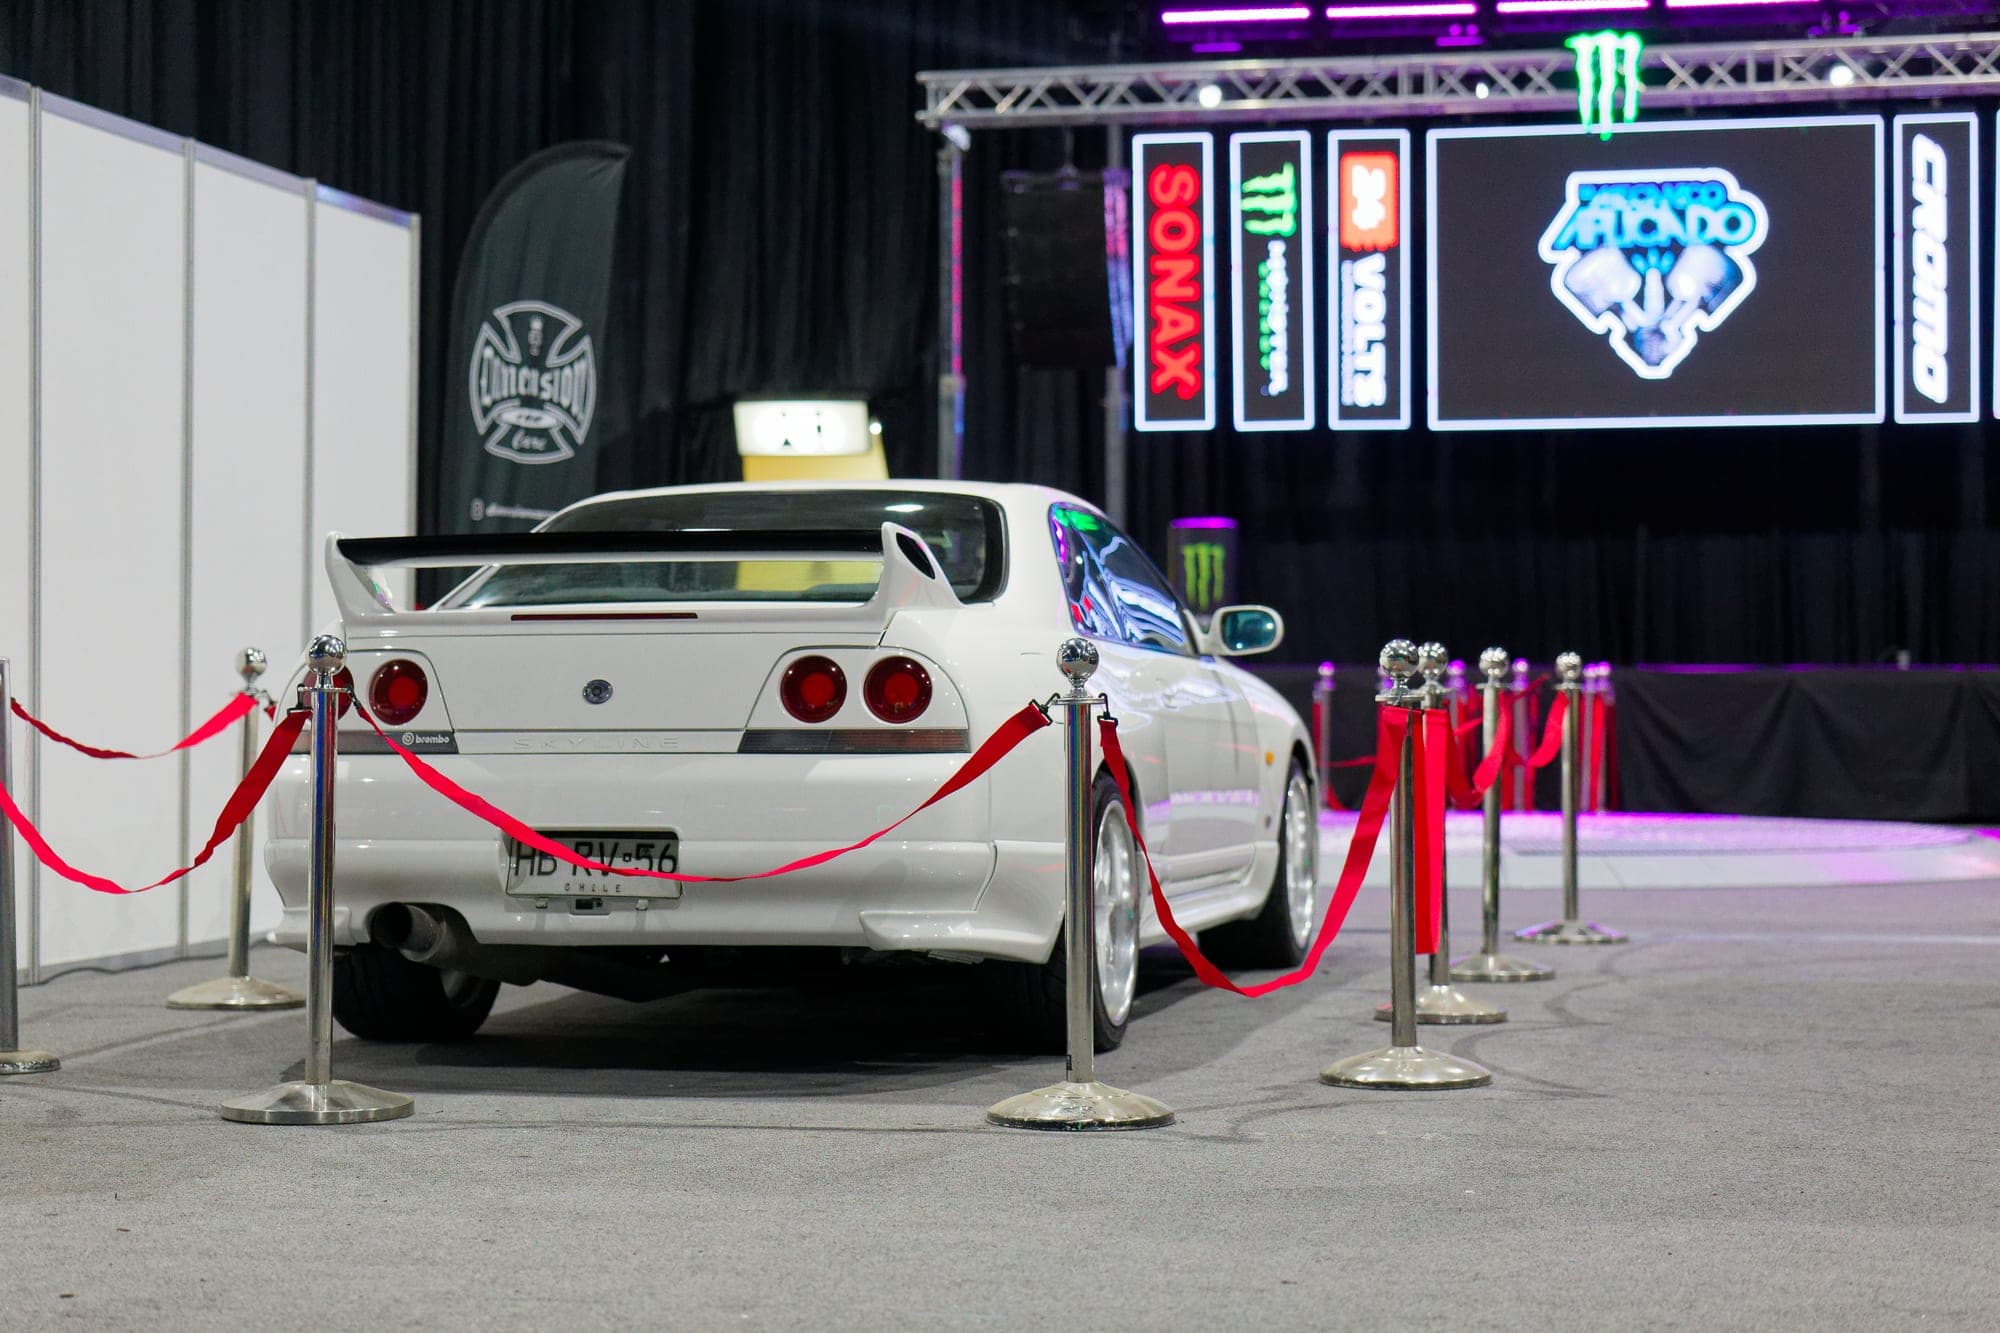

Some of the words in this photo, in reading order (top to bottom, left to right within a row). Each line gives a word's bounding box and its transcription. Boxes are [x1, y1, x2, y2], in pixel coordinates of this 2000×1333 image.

[1149, 163, 1201, 397] SONAX
[1353, 253, 1386, 407] VOLTS
[415, 734, 450, 744] brembo
[513, 735, 681, 749] SKYLINE
[564, 883, 622, 893] CHILE
